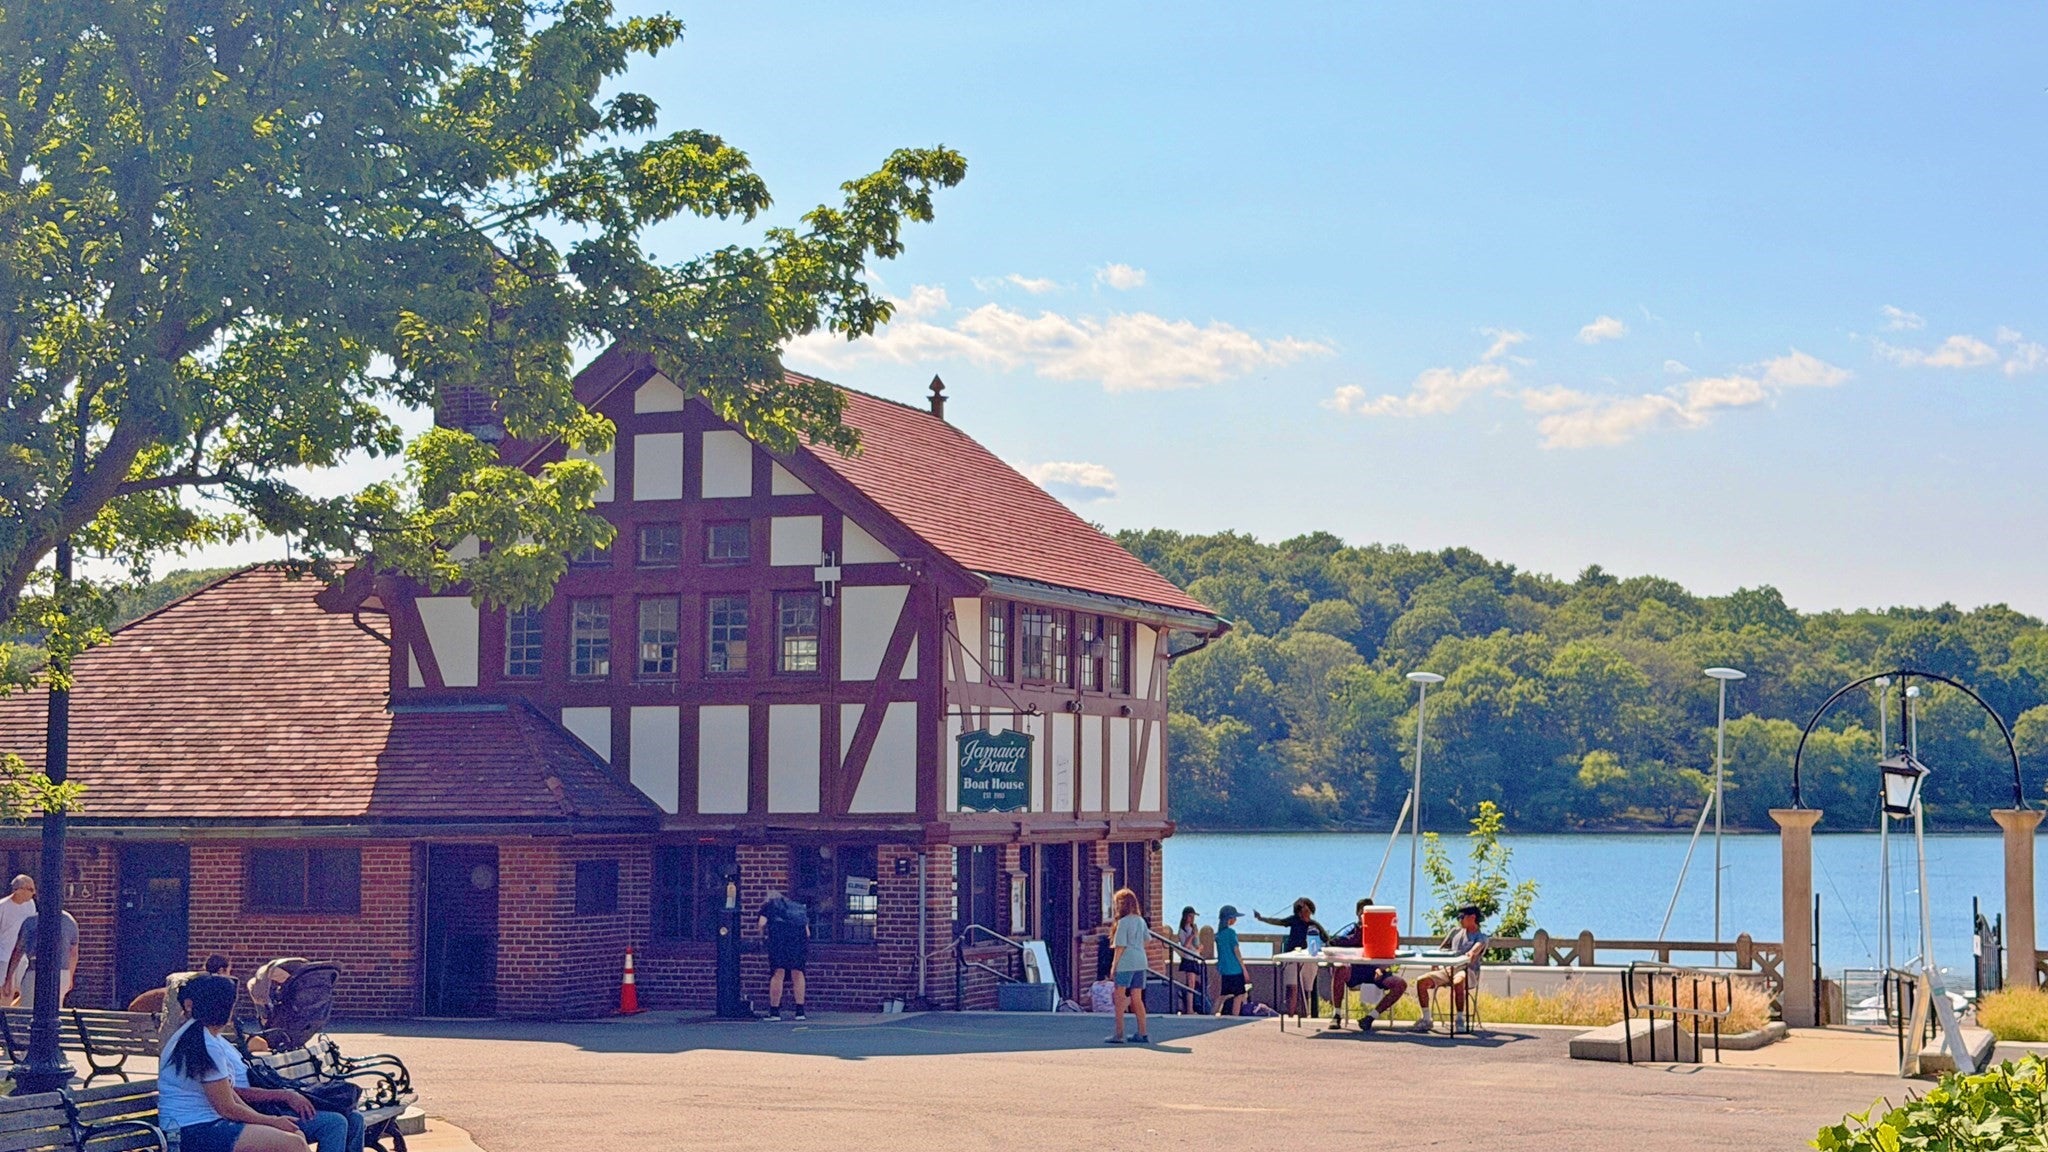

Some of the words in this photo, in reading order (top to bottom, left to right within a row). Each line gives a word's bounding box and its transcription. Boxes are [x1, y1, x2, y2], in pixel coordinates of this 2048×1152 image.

[960, 739, 1027, 767] Jamaica
[974, 758, 1018, 773] Pond
[963, 777, 989, 789] Boat
[991, 777, 1024, 789] House
